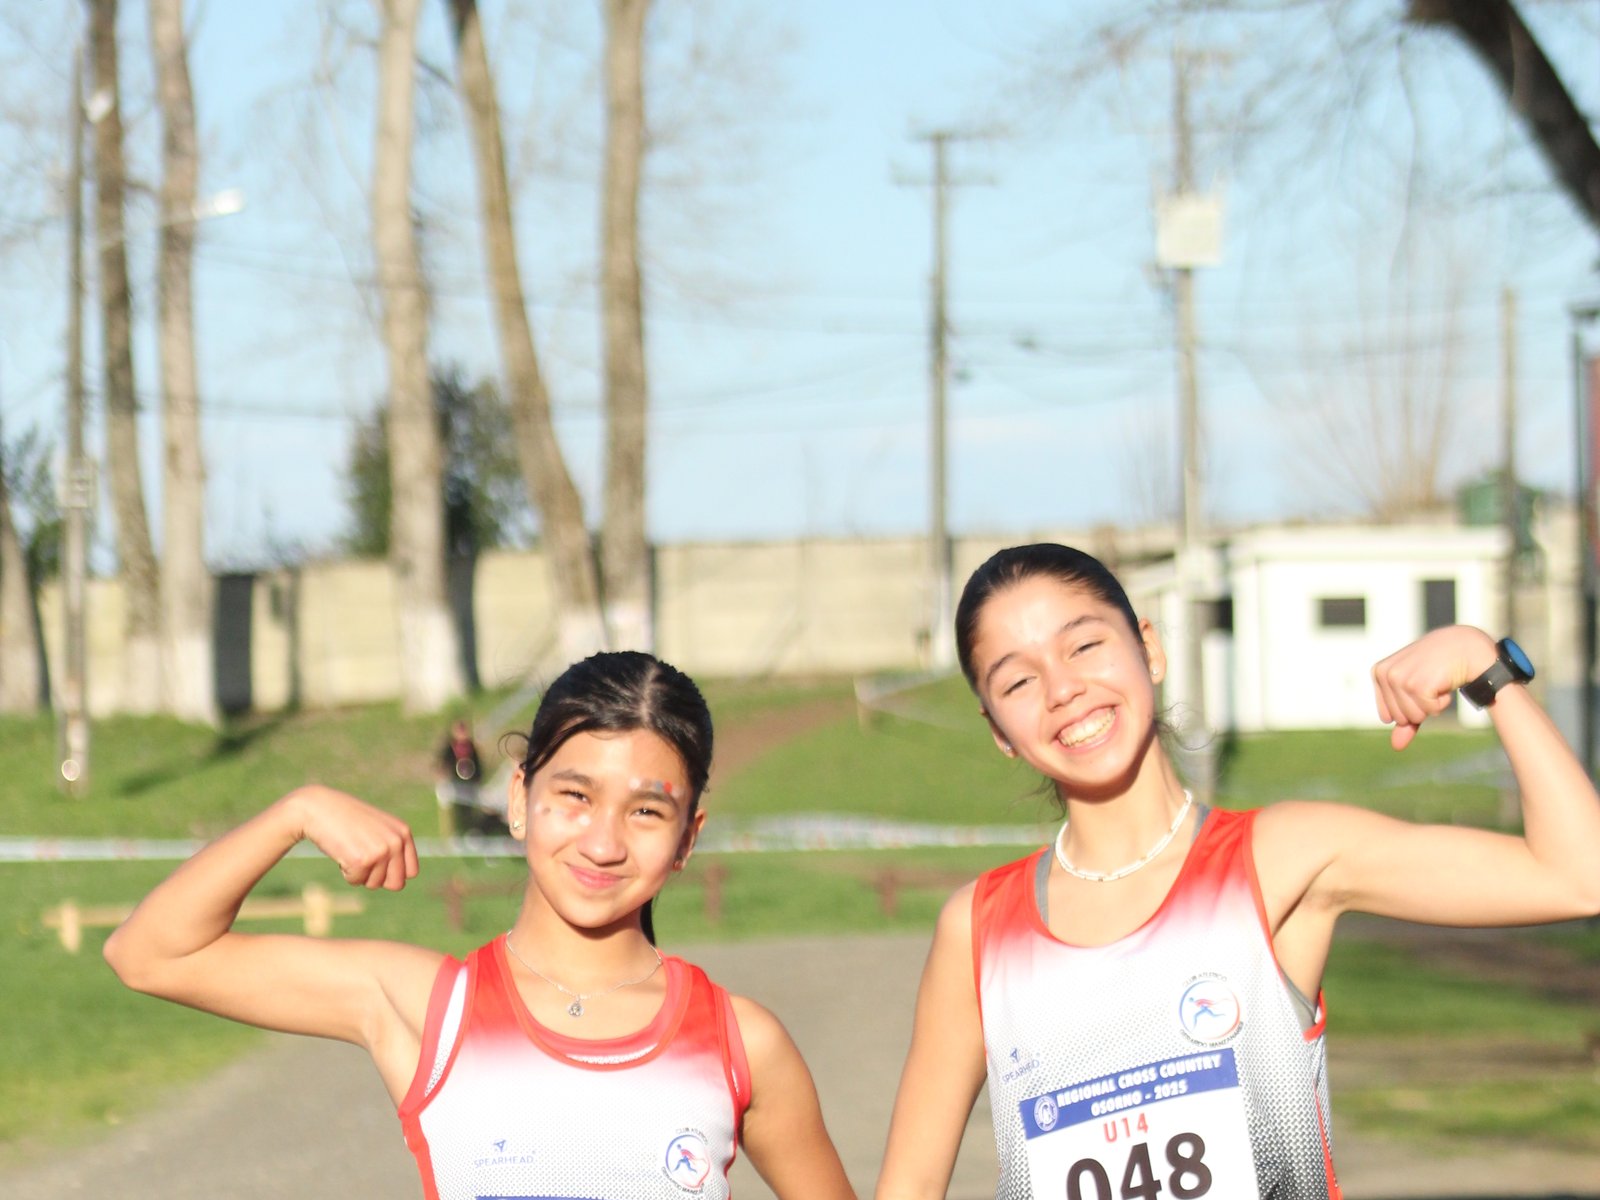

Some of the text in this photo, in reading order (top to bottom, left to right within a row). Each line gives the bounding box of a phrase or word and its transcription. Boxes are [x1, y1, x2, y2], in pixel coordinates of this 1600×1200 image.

[1056, 1053, 1221, 1108] REGIONAL CROSS COUNTRY
[1091, 1090, 1143, 1117] OSORNO
[1154, 1079, 1188, 1100] 2025
[1103, 1112, 1149, 1143] U14
[474, 1155, 534, 1168] SPEARHEAD
